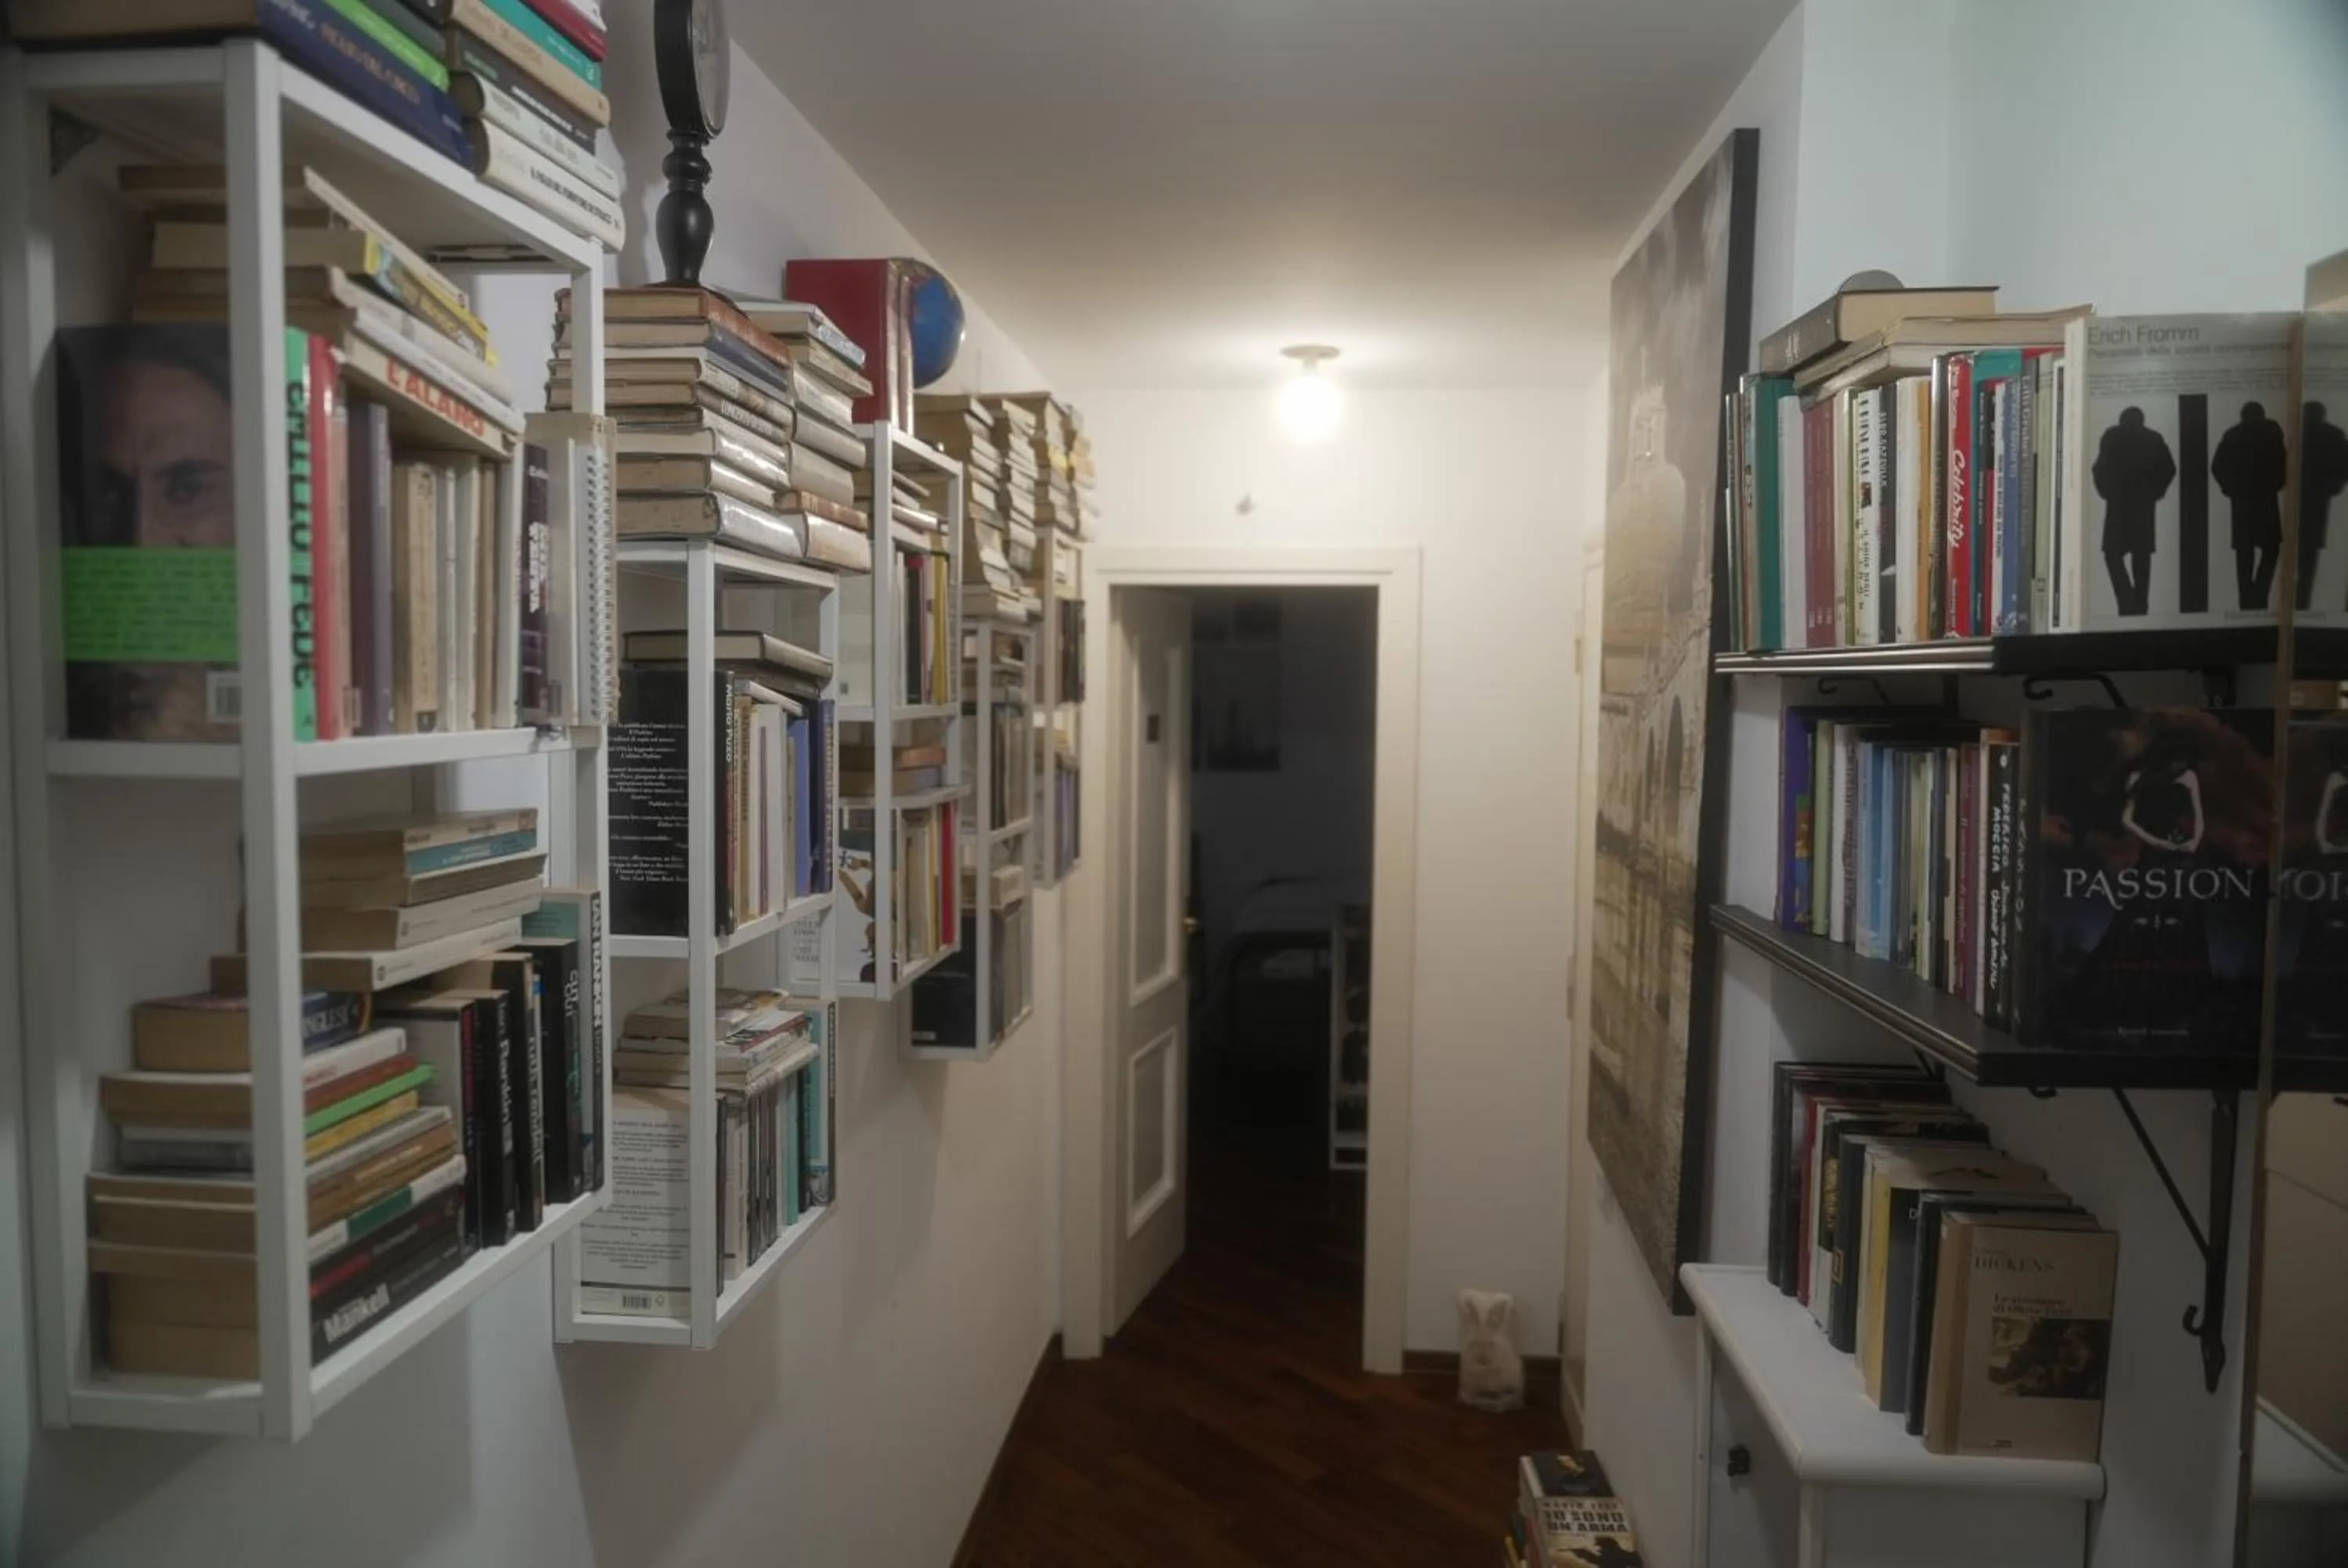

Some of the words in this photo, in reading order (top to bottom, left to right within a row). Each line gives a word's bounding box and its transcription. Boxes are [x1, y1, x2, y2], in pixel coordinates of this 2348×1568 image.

[2087, 325, 2131, 345] Erich
[2137, 325, 2200, 342] Fromm
[1948, 449, 1965, 548] Celebrity
[725, 684, 733, 725] Mario
[725, 728, 733, 762] Puzo
[1991, 807, 2001, 872] MOCCIA
[2001, 782, 2011, 866] FEDERICO
[2015, 797, 2028, 933] PASSION
[2063, 867, 2254, 910] PASSION
[592, 898, 600, 937] IAN
[592, 941, 601, 1027] RANKIN
[499, 1038, 512, 1124] Rankin
[1975, 1255, 2055, 1272] DICKENS
[322, 1282, 390, 1343] Mankell
[1545, 1510, 1565, 1522] IO
[1570, 1509, 1624, 1523] SONO
[1547, 1521, 1629, 1533] UN'ARMA
